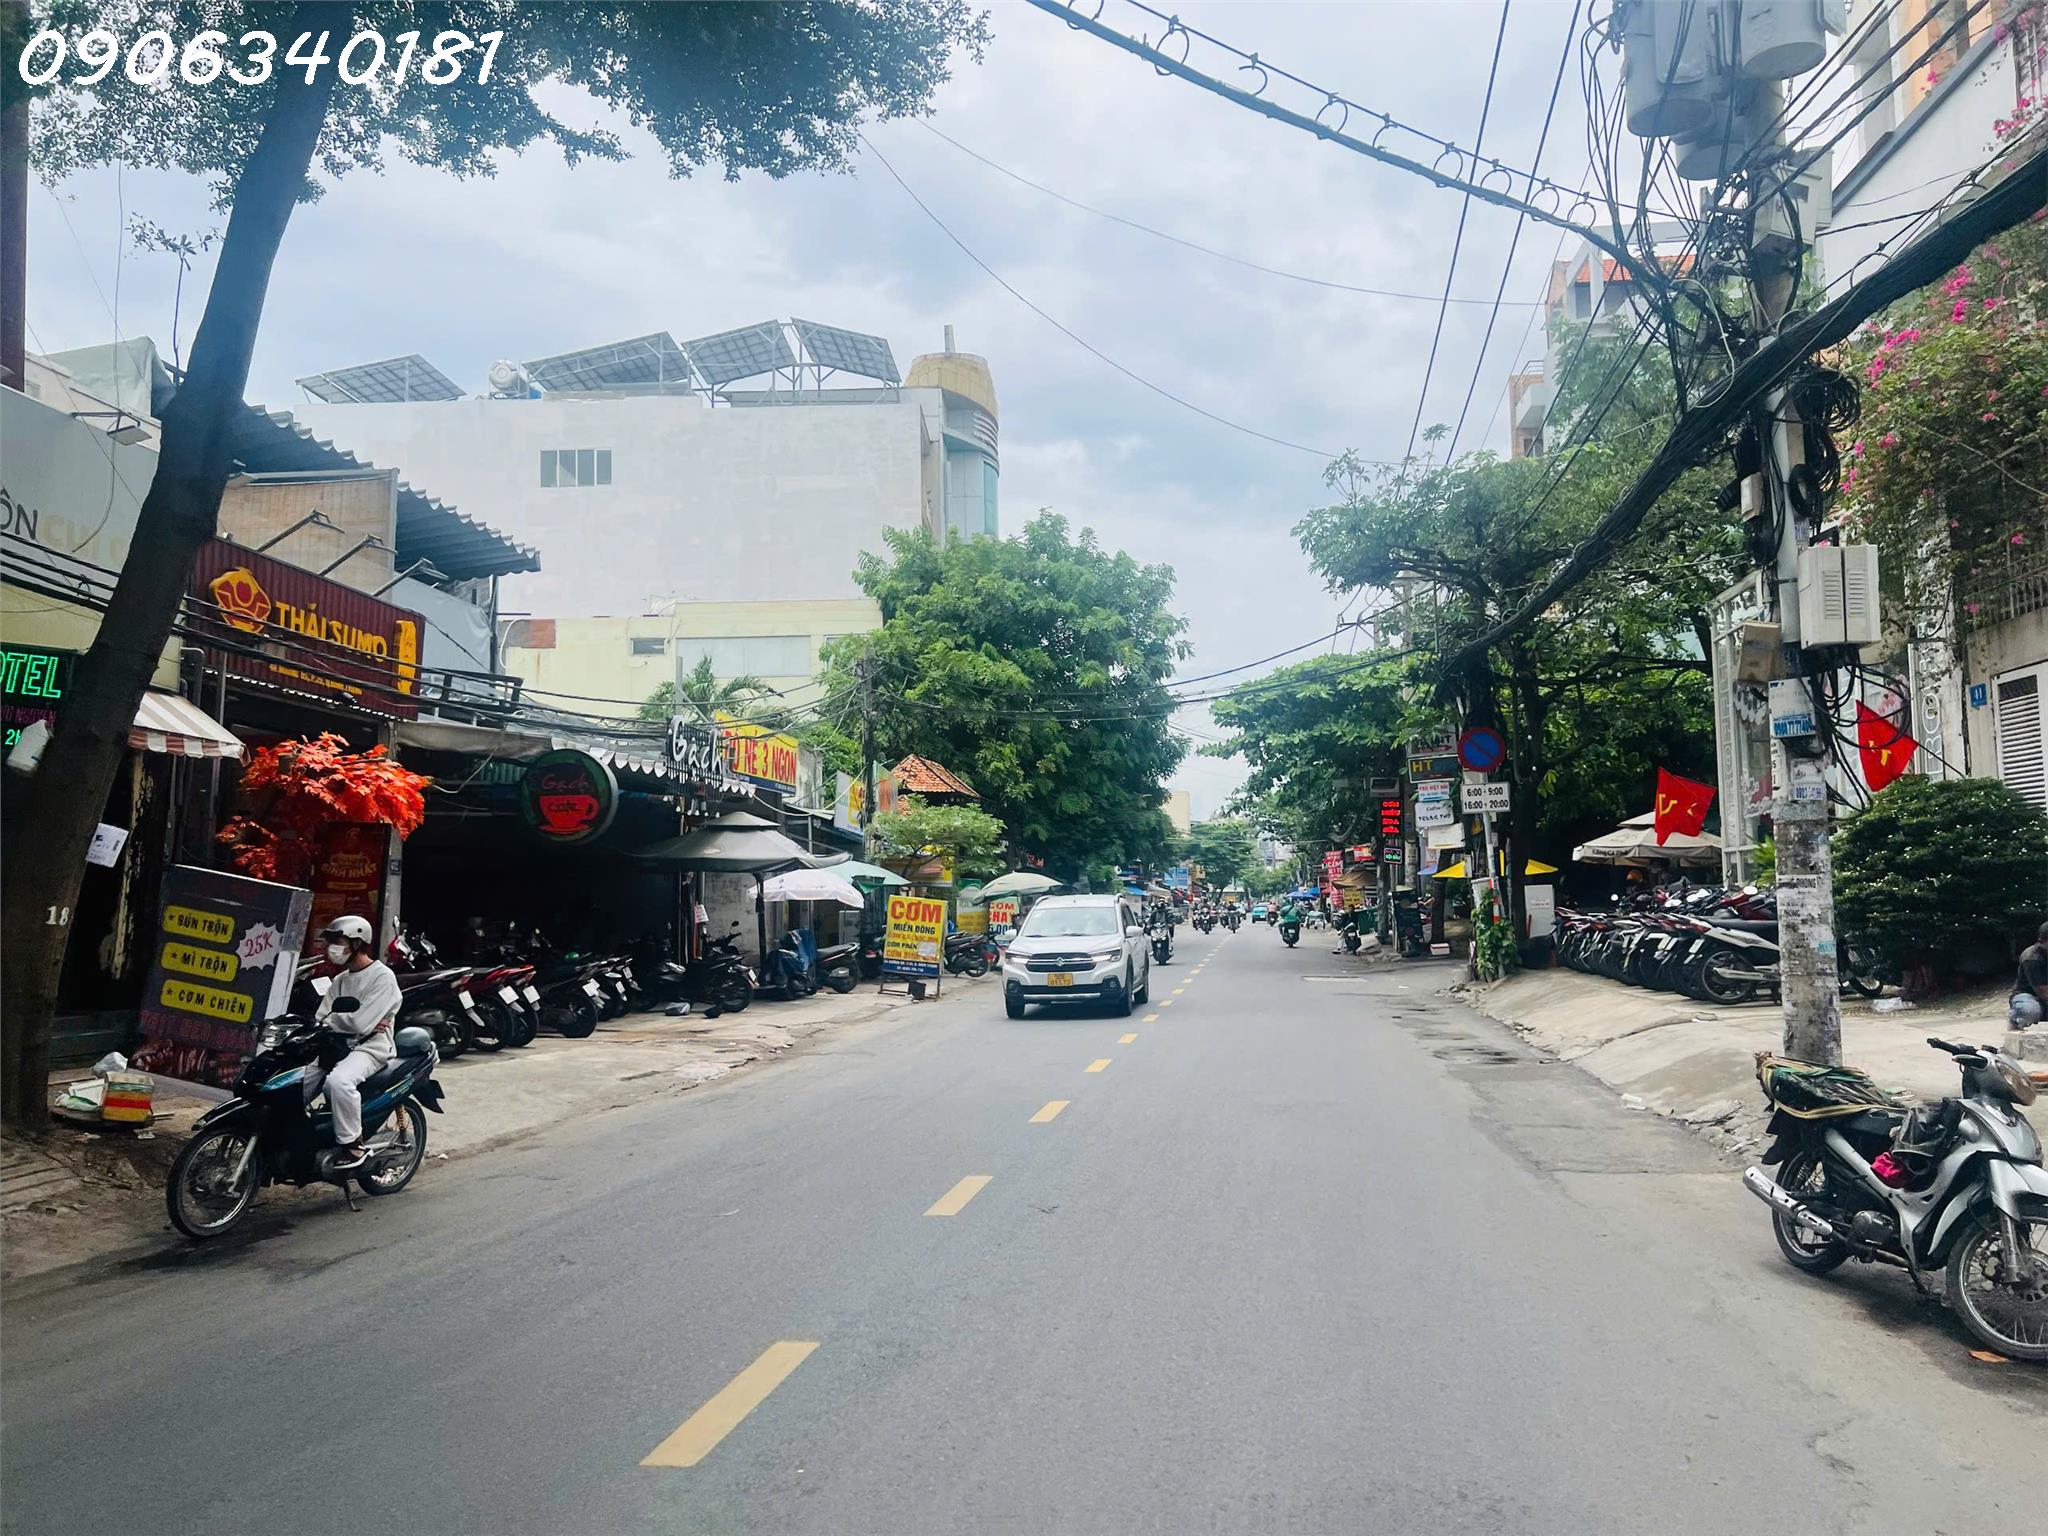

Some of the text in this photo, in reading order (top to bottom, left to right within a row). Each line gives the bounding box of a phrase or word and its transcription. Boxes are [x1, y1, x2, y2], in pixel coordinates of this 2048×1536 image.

[1974, 686, 1983, 700] 41
[761, 742, 769, 777] 3
[771, 745, 798, 785] NGON
[1467, 788, 1482, 797] 6:00
[1488, 787, 1503, 796] 9:00
[1464, 801, 1483, 810] 16:00
[1489, 800, 1509, 809] 20:00
[45, 905, 70, 926] 18
[890, 900, 942, 923] CƠM
[176, 910, 230, 937] BÚN TRỘN
[244, 931, 273, 958] 25K
[199, 956, 229, 974] TRỘN
[177, 989, 247, 1015] CƠM CHIÊN
